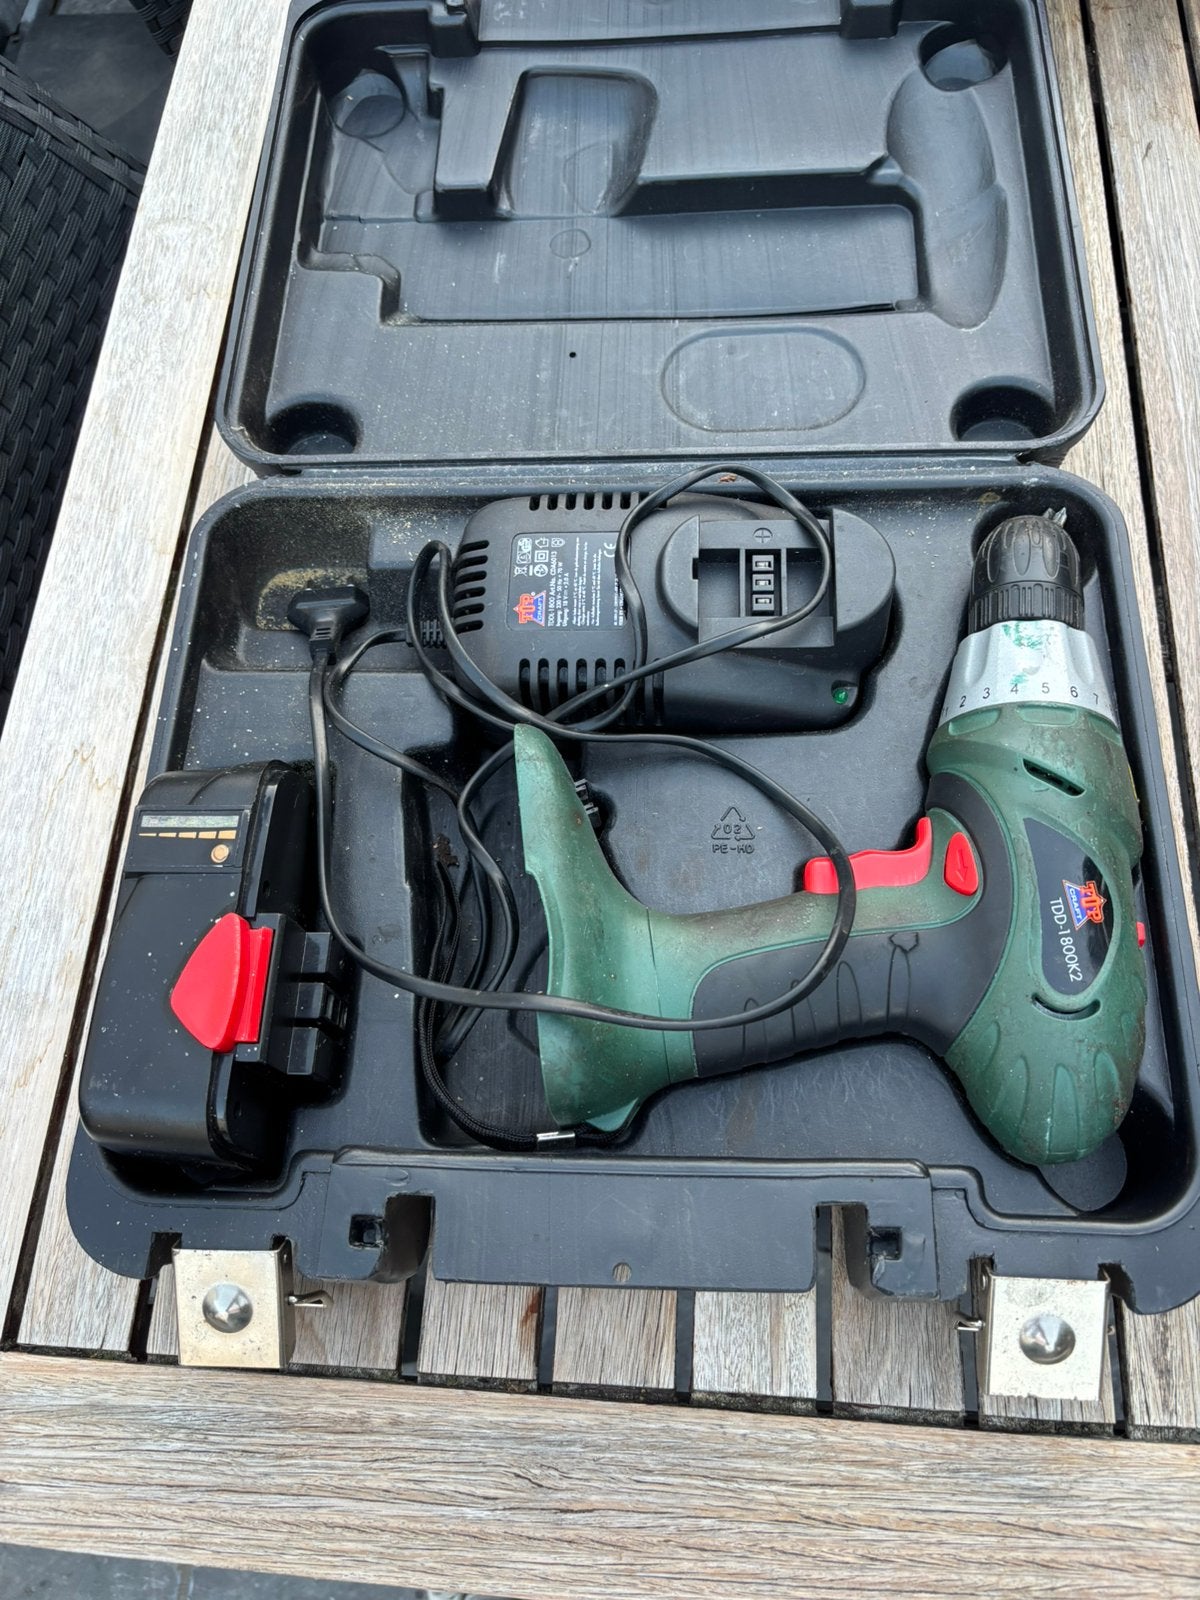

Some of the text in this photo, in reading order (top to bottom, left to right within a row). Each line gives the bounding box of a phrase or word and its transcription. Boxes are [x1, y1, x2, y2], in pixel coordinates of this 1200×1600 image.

[959, 695, 967, 708] 2
[982, 687, 991, 700] 3
[1010, 683, 1019, 695] 4
[1041, 682, 1050, 694] 5
[1070, 686, 1079, 698] 6
[1092, 692, 1099, 705] 7
[723, 823, 742, 835] 02
[711, 843, 756, 855] PE-HD
[1068, 887, 1083, 920] CRAFT
[1079, 880, 1105, 924] TOP
[1050, 896, 1083, 983] TDD-1800K2
